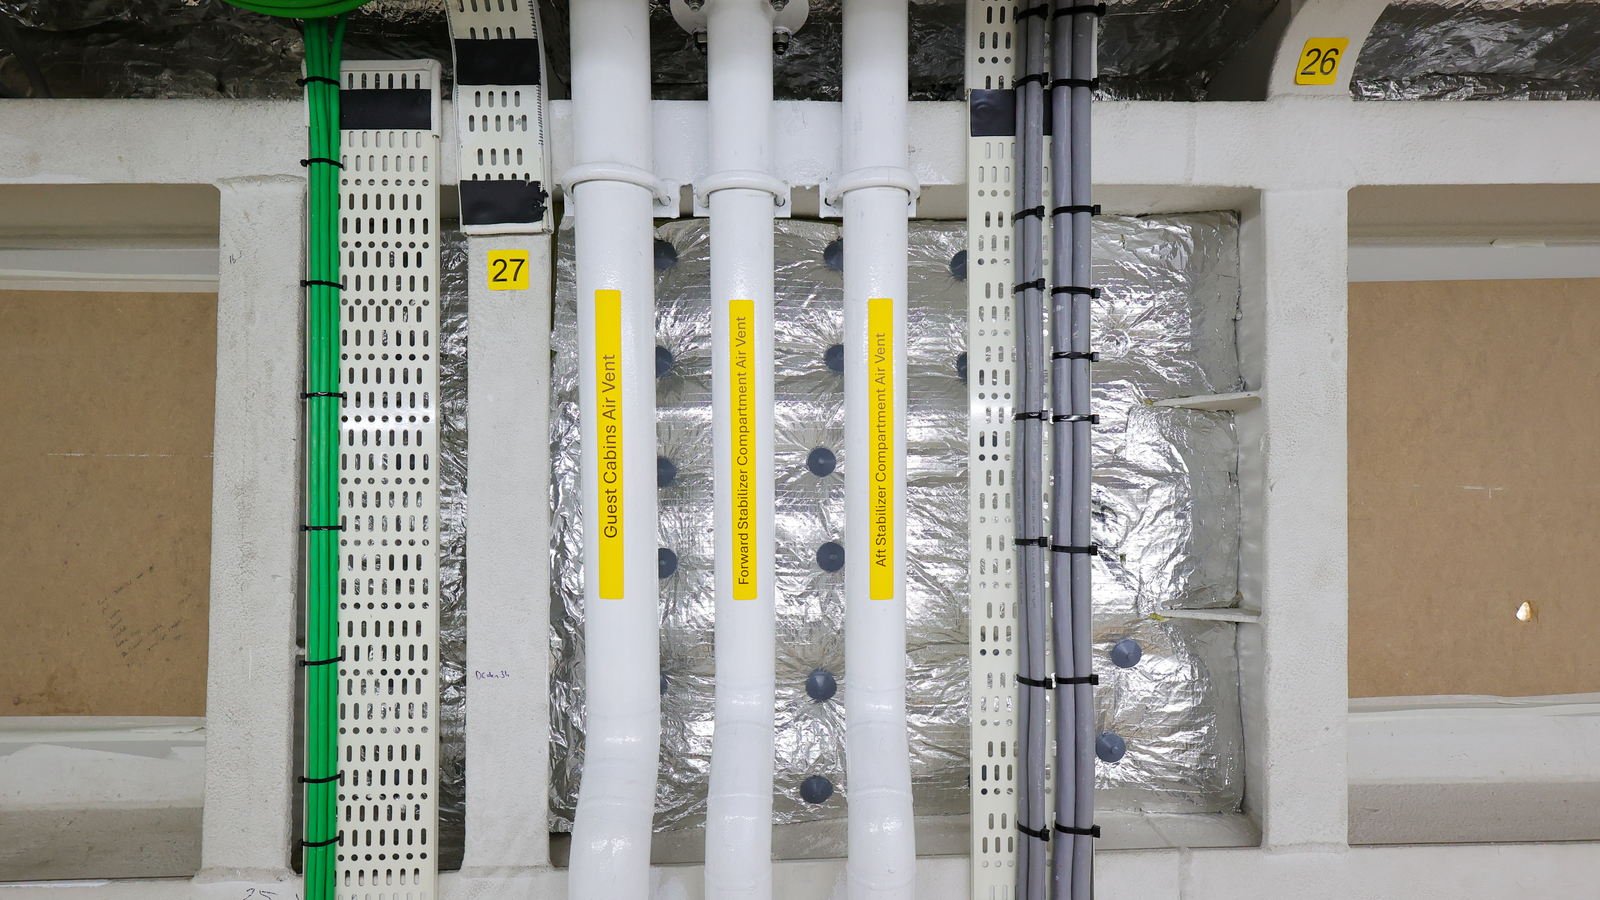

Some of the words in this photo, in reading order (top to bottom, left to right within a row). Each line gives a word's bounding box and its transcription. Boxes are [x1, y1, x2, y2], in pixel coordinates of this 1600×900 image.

[1300, 47, 1339, 75] 26
[492, 258, 525, 282] 27
[735, 316, 747, 348] Vent
[874, 332, 886, 364] Vent
[601, 354, 616, 393] Vent
[735, 352, 747, 369] Air
[874, 368, 886, 385] Air
[602, 397, 616, 421] Air
[736, 372, 750, 466] Compartment
[875, 389, 889, 482] Compartment
[602, 425, 617, 484] Cabins
[603, 488, 618, 539] Guest
[736, 469, 749, 530] Stabilizer
[875, 485, 887, 546] Stabilizer
[737, 533, 749, 585] Forward
[875, 549, 887, 567] Aft
